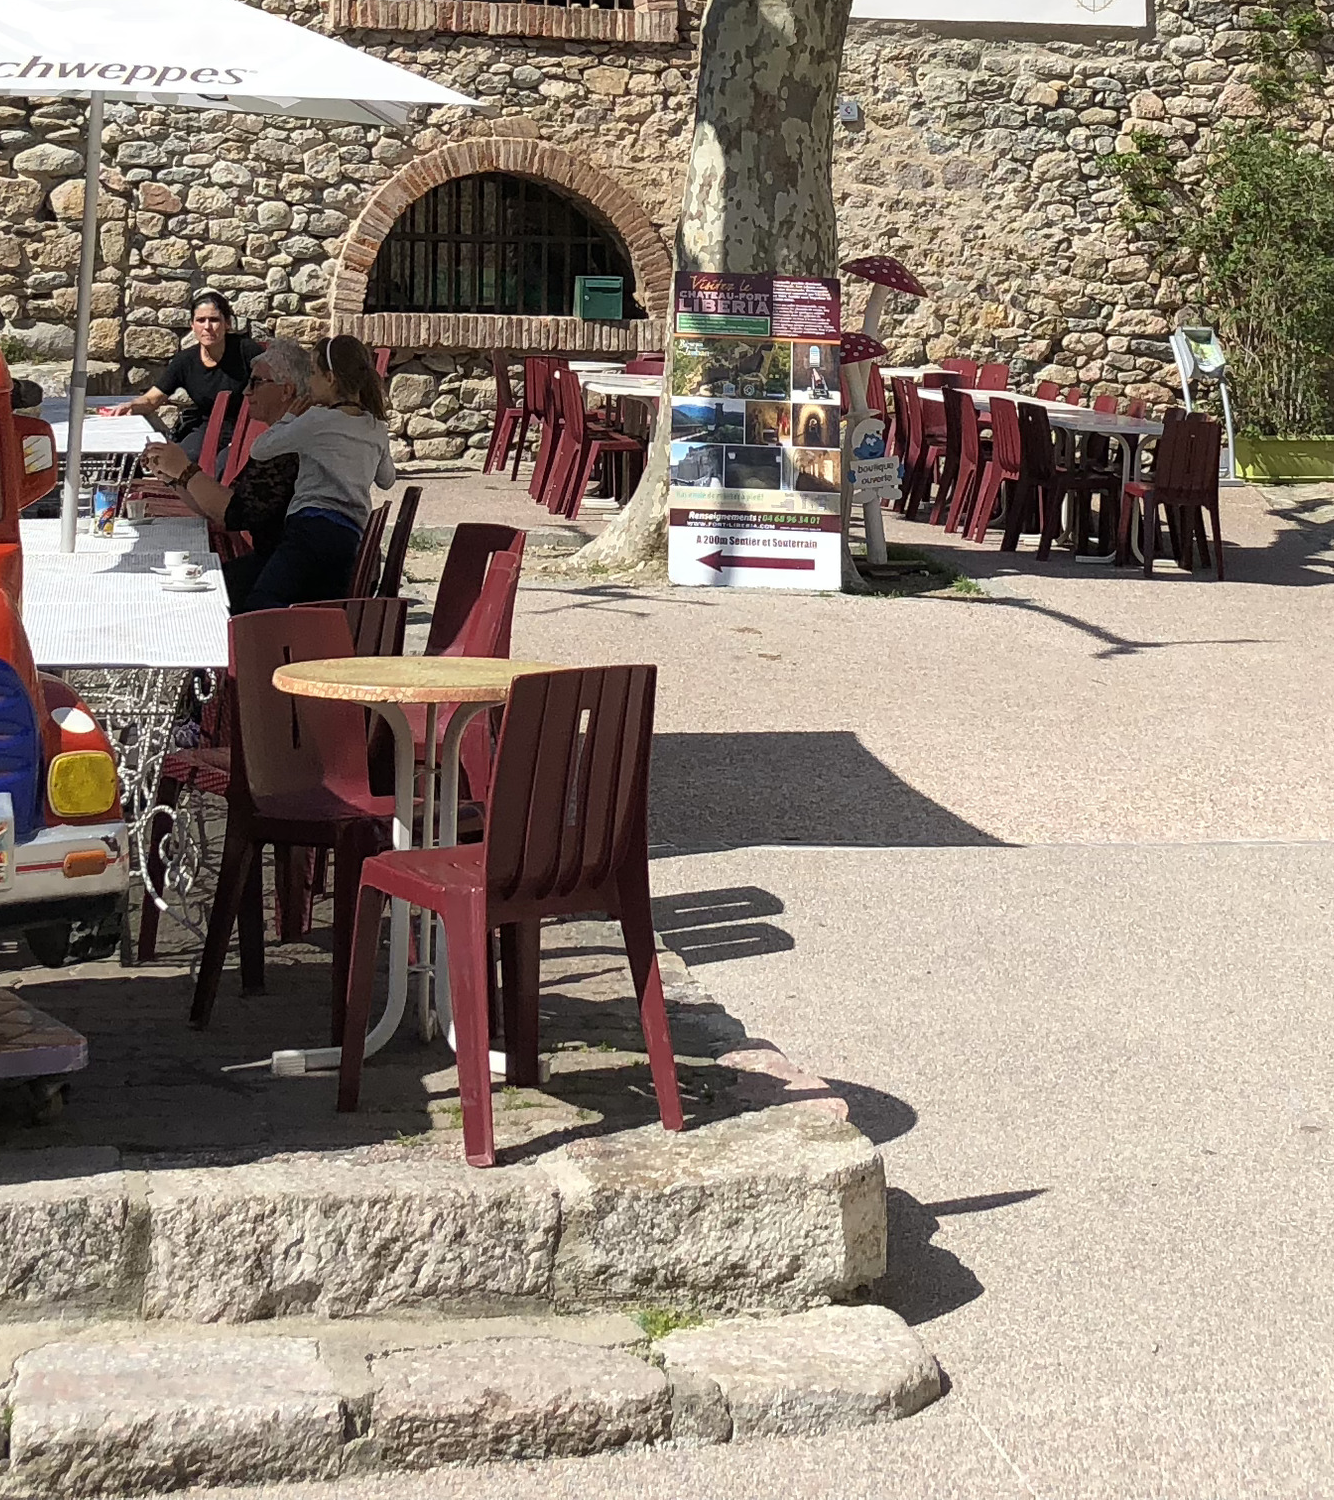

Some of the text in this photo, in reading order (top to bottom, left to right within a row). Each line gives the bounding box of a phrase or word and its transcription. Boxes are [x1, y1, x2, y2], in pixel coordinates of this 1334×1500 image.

[678, 298, 771, 316] LIBERIA
[857, 462, 894, 473] boutique
[861, 474, 893, 485] ouverte
[762, 514, 773, 523] 04
[703, 535, 728, 545] 200m
[729, 536, 761, 546] Sentier
[762, 538, 771, 547] et
[772, 538, 818, 549] Souterrain
